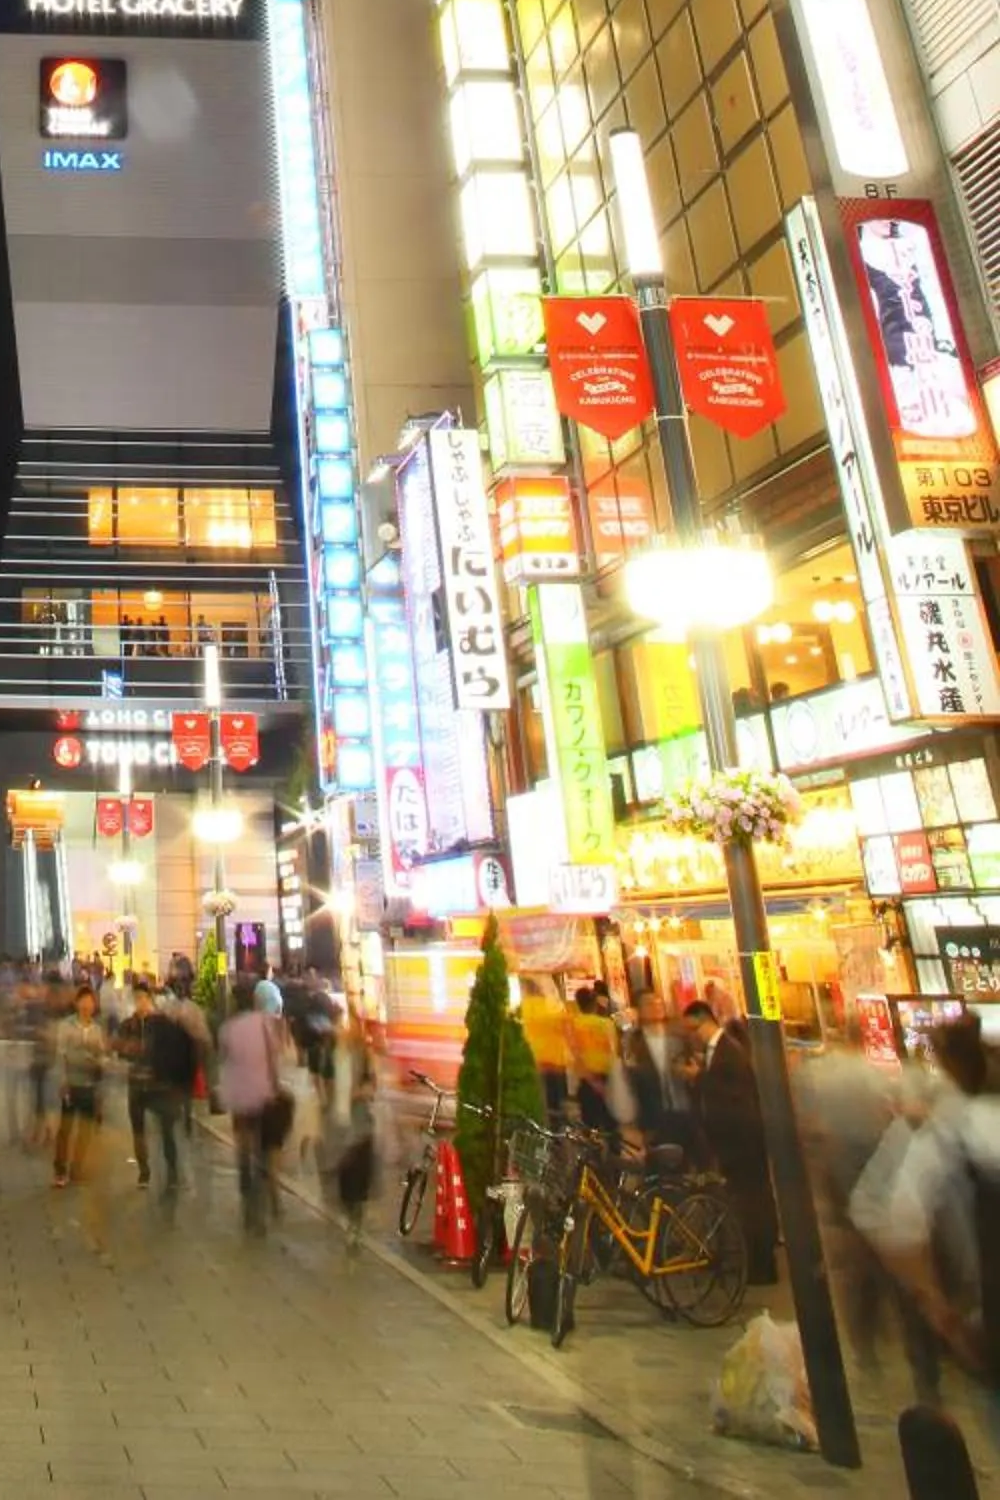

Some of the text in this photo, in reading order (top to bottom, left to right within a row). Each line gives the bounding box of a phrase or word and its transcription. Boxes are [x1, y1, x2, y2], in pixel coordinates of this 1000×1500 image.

[43, 151, 121, 170] IMAX
[920, 493, 1000, 524] 東京ビル
[897, 572, 967, 592] ルノアール
[85, 741, 151, 765] TOHO
